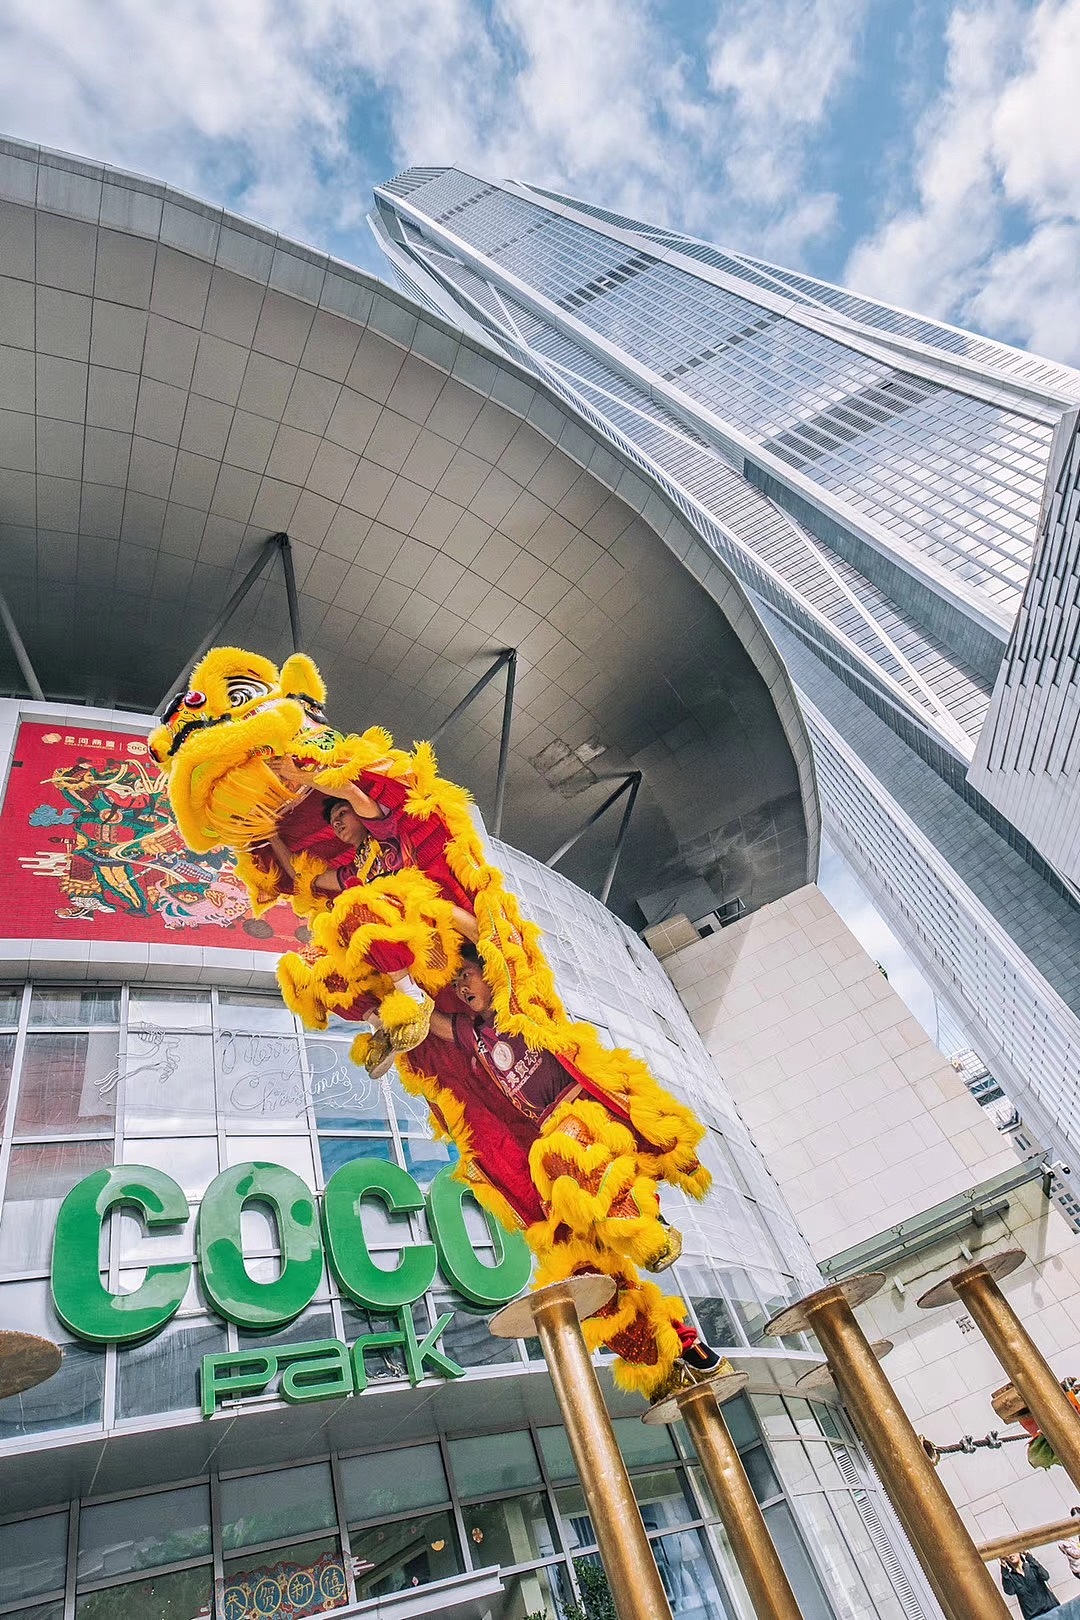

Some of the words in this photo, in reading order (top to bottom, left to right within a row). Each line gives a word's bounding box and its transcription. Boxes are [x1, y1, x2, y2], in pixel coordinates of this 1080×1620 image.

[50, 1157, 533, 1343] COCO
[224, 1569, 344, 1620] 恭贺新禧
